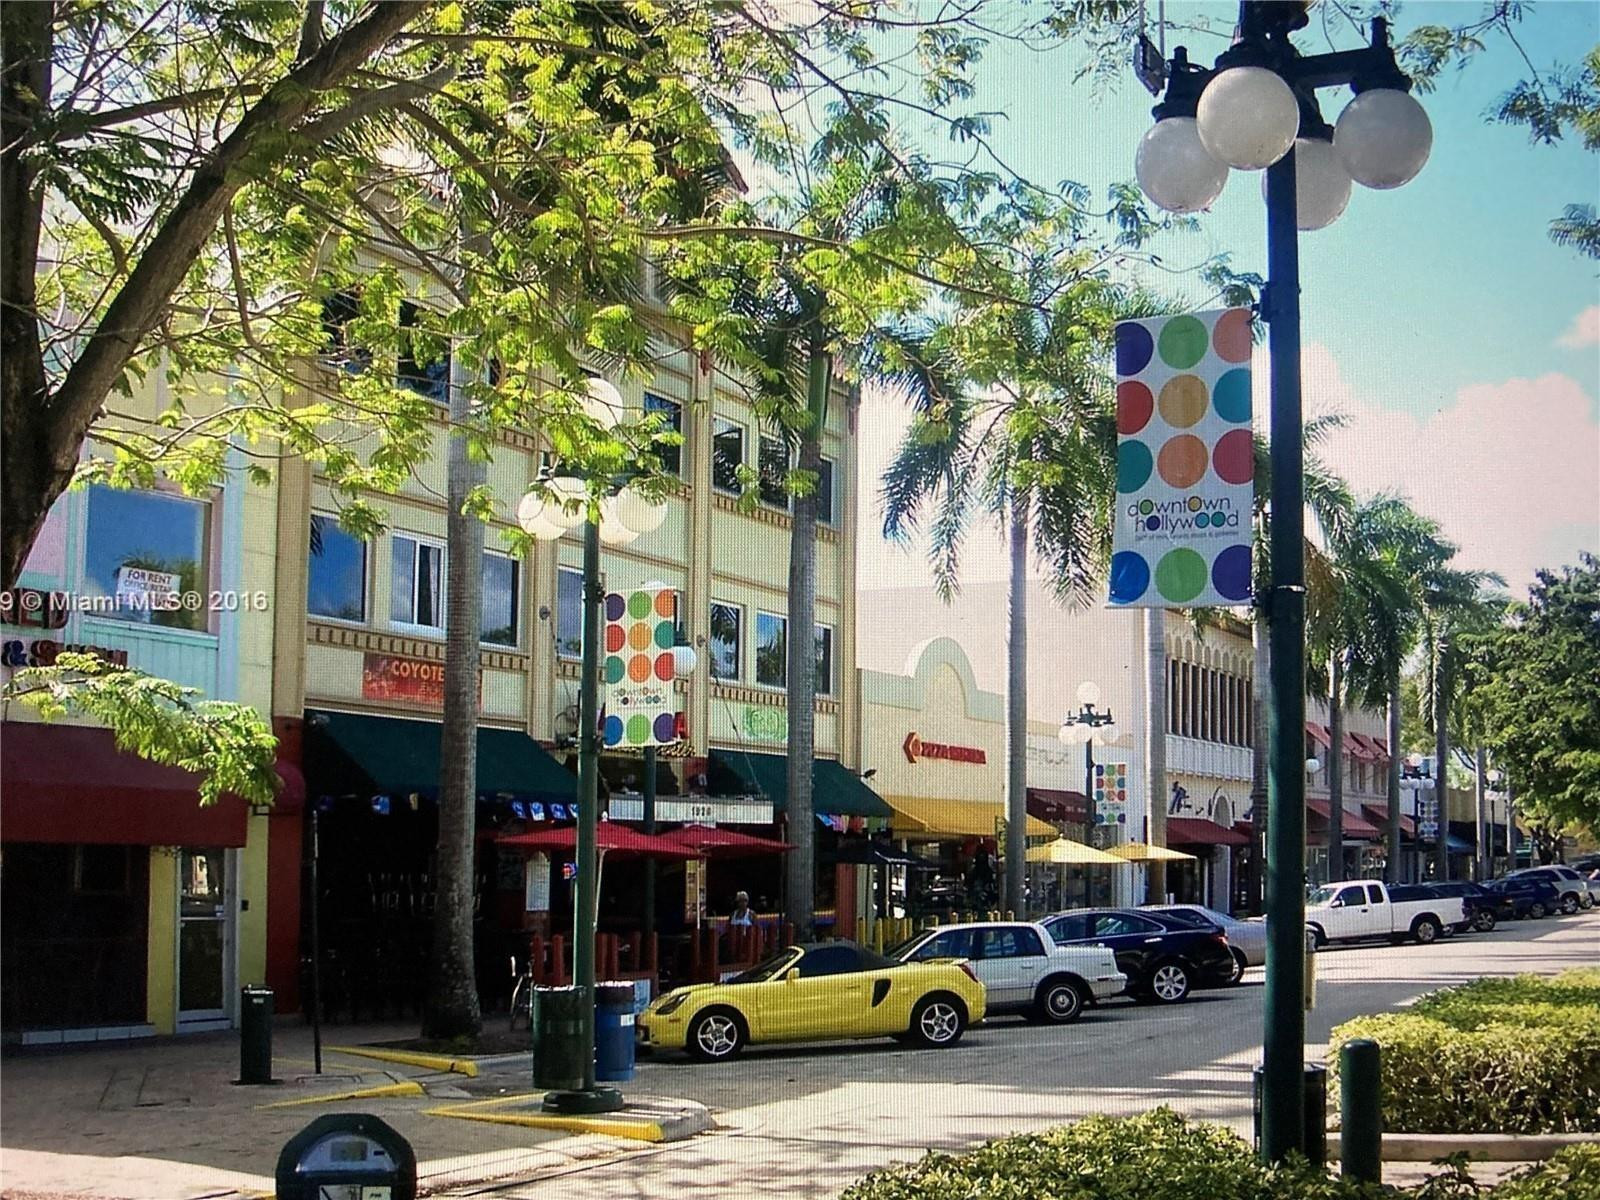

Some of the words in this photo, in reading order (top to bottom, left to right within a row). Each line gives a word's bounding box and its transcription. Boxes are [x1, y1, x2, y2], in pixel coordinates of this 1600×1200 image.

[1128, 496, 1231, 517] downtown
[1135, 510, 1239, 534] hollywood
[127, 570, 147, 581] FOR
[147, 572, 172, 585] RENT
[391, 660, 445, 682] COYOTE
